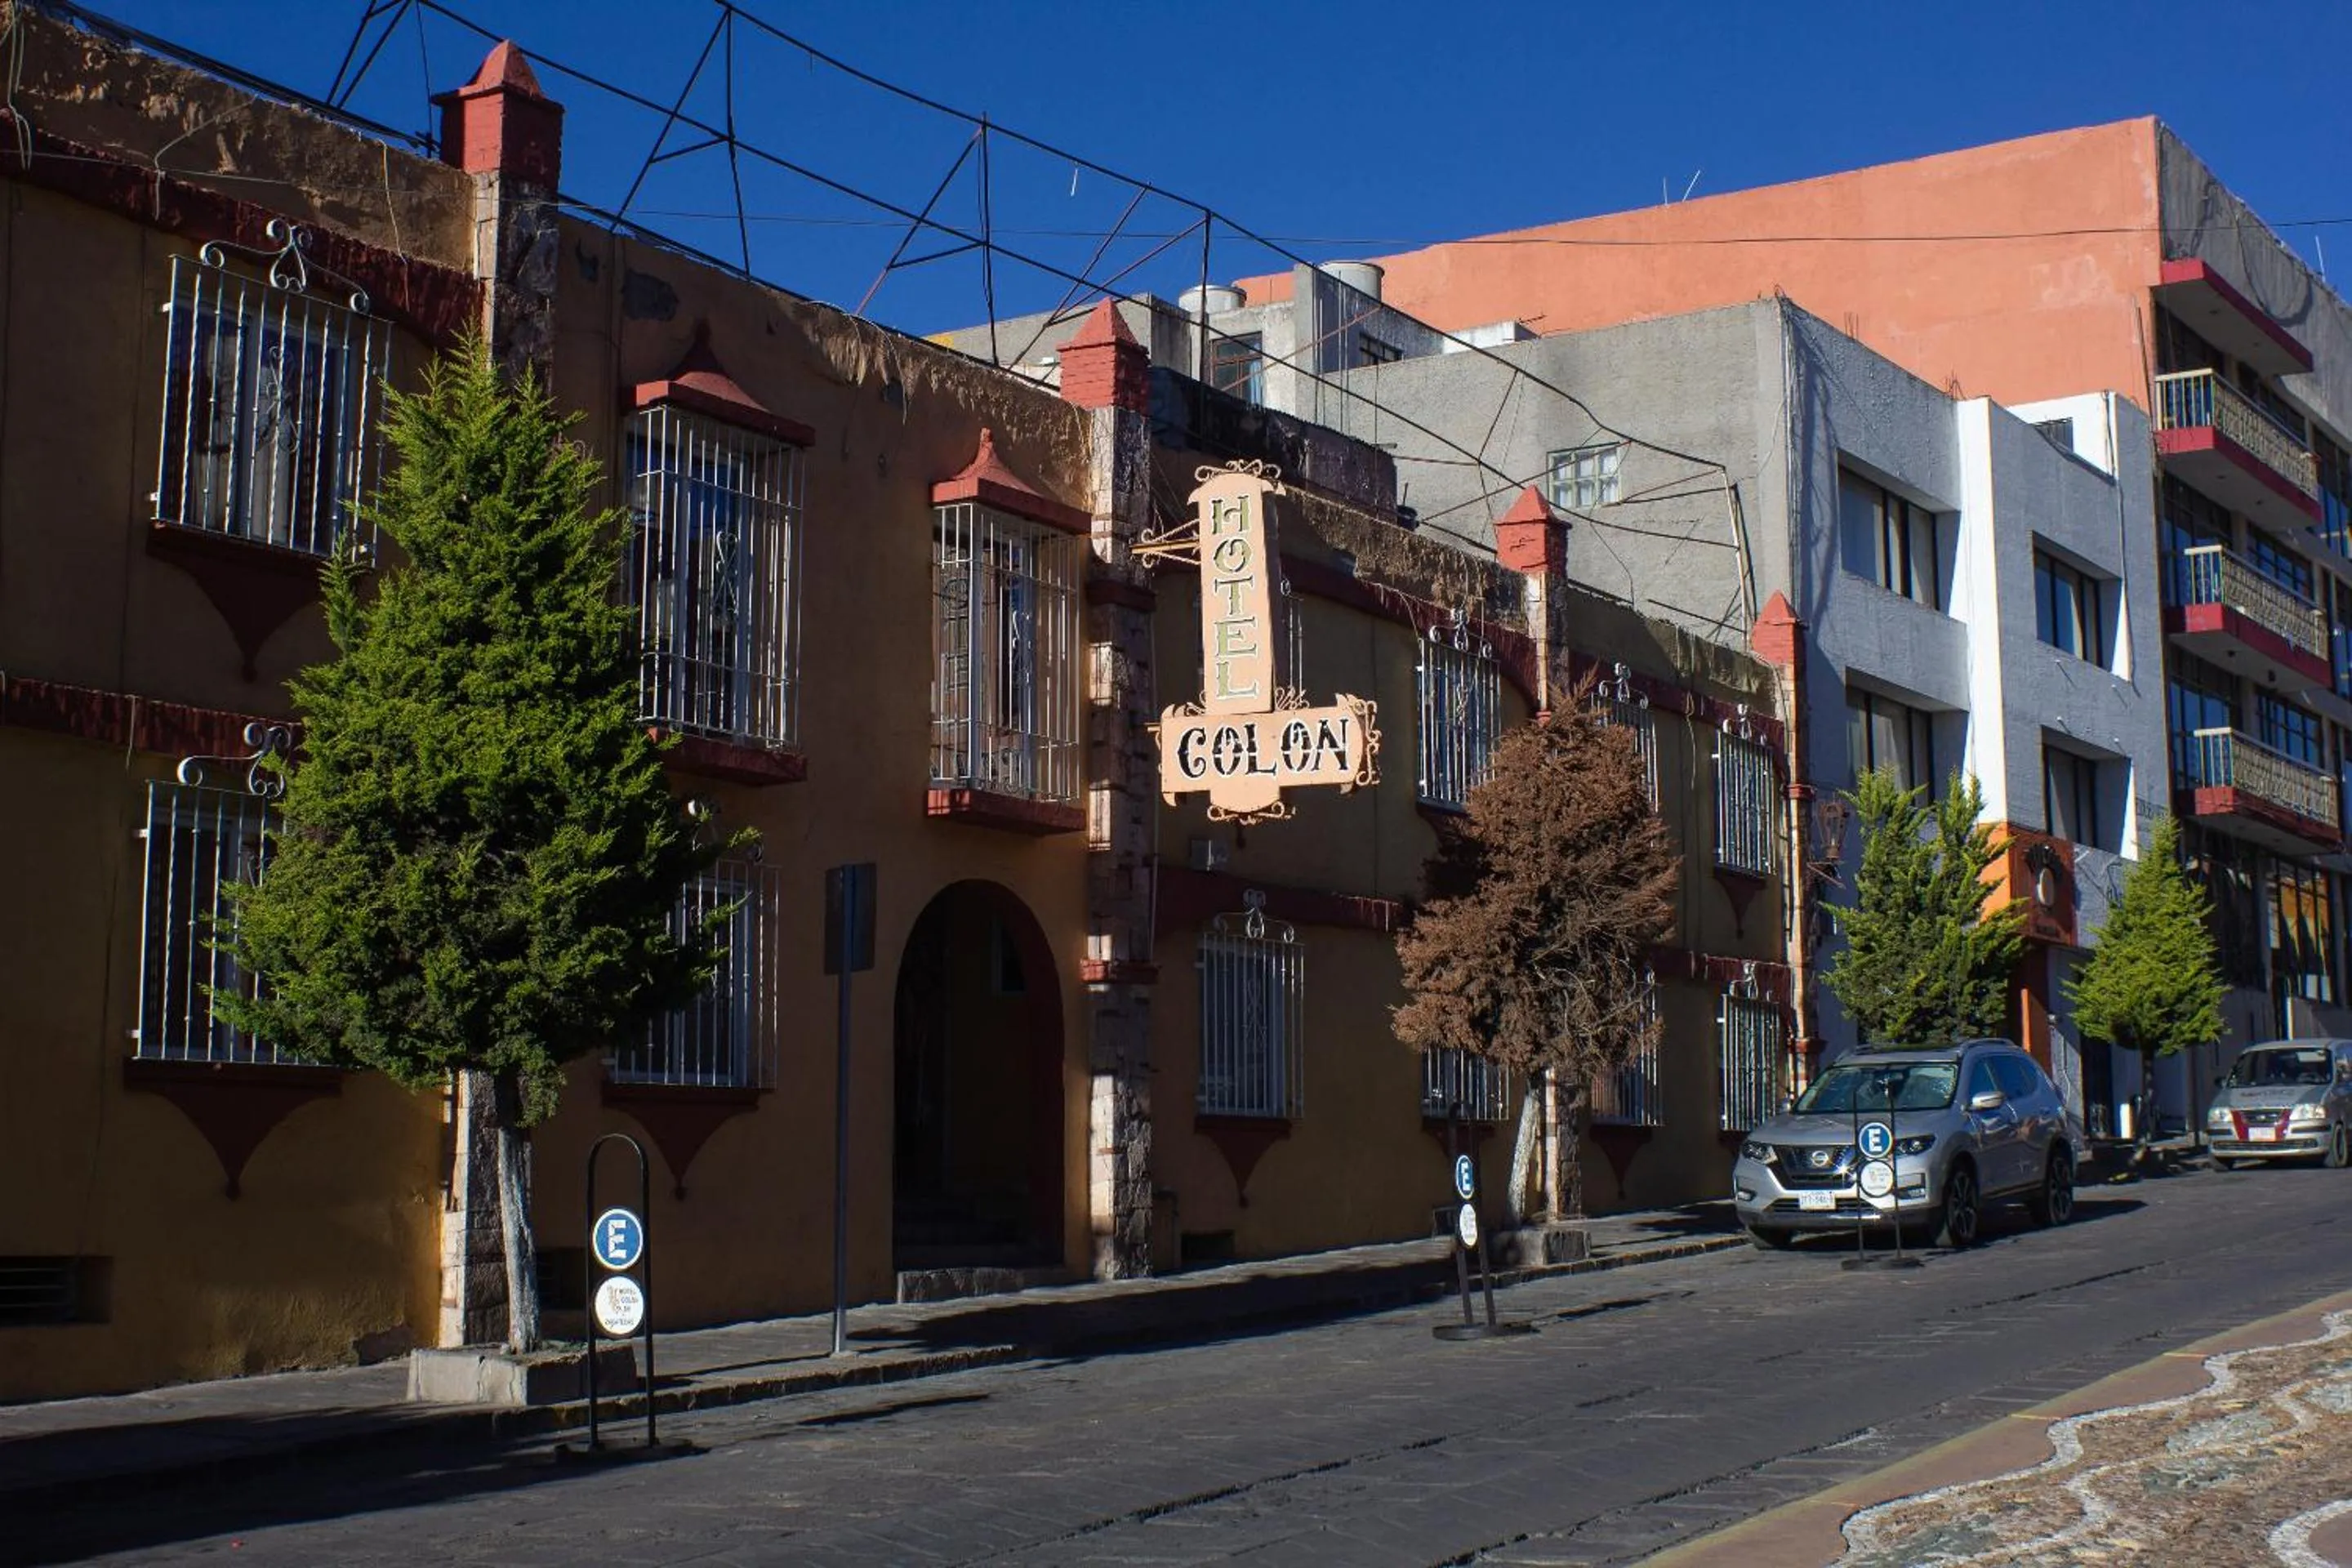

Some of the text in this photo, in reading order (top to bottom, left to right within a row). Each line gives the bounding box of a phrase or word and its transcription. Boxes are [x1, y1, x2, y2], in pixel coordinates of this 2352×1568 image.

[1210, 494, 1258, 700] HOTEL
[1177, 715, 1349, 781] COLON
[1869, 1128, 1882, 1152] E
[1460, 1161, 1471, 1191] E
[608, 1219, 626, 1258] E
